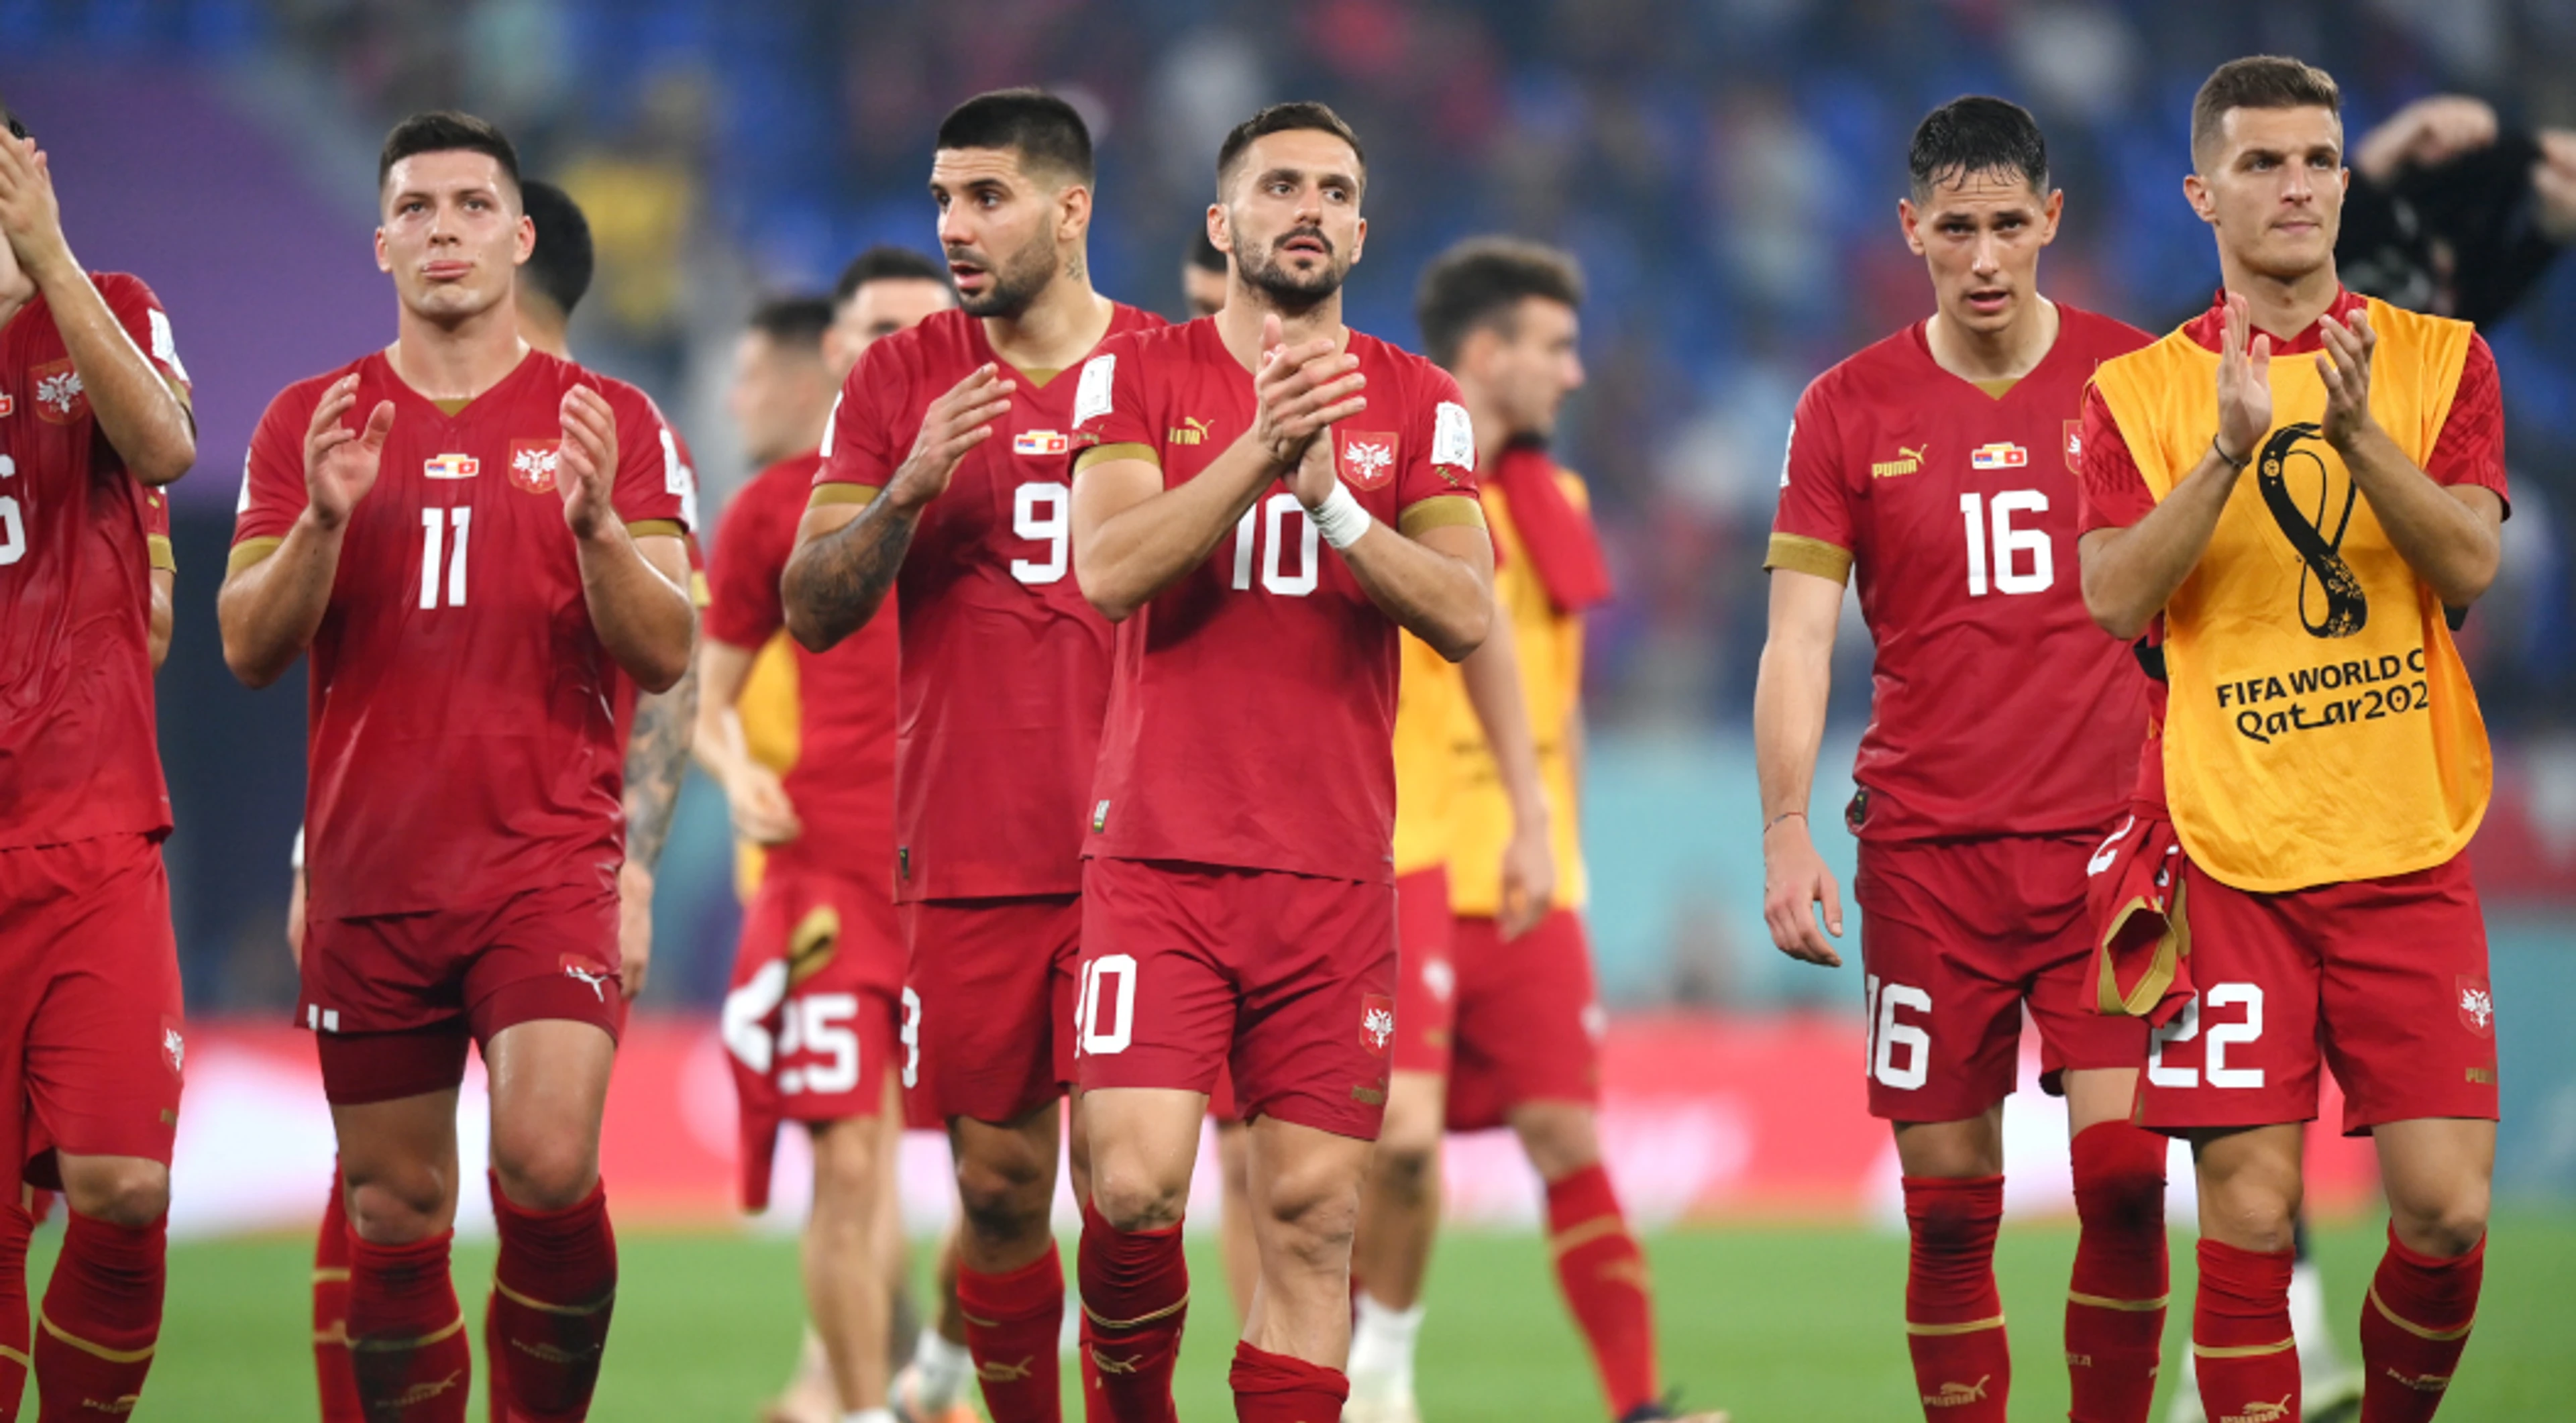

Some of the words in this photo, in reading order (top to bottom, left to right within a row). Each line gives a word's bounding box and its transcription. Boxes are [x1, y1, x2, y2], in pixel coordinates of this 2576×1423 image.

[1872, 459, 1918, 478] PUMA
[420, 507, 471, 609] 11
[1010, 482, 1069, 584] 9
[1231, 493, 1318, 596] 10
[1960, 489, 2054, 596] 16
[2216, 675, 2286, 708] FIFA
[2289, 654, 2401, 695] WORLD
[2148, 983, 2265, 1088] 22
